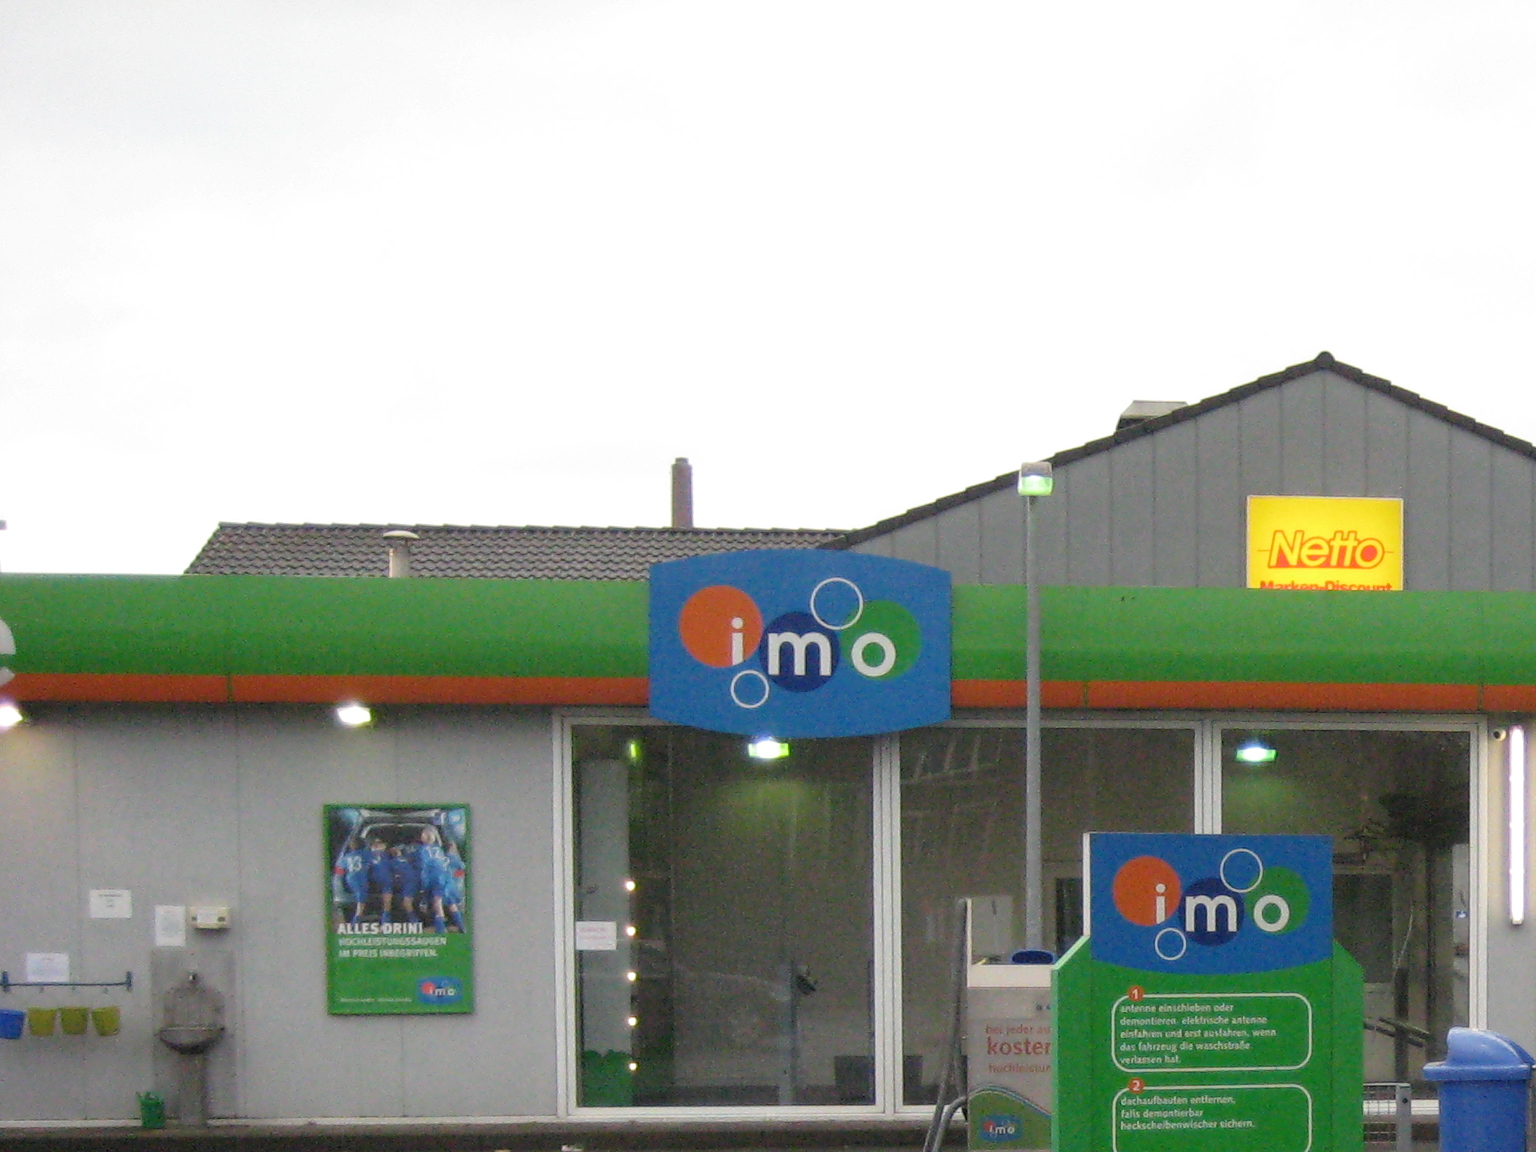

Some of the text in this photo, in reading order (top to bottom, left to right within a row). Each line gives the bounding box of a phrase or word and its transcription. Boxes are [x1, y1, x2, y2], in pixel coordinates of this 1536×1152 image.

[1268, 530, 1385, 569] Netto
[731, 617, 891, 677] imo
[1155, 882, 1290, 932] imo
[337, 922, 379, 934] ALLES
[1121, 1003, 1234, 1013] antenne einschieben oder
[1231, 1016, 1267, 1024] antenne
[1006, 1024, 1034, 1035] jeder
[1165, 1029, 1183, 1038] und
[1120, 1043, 1136, 1051] das
[1138, 1042, 1177, 1052] fahrzeug
[1179, 1041, 1193, 1050] die
[1120, 1096, 1188, 1106] dachaufbauten
[1120, 1108, 1204, 1119] falls demontierbar
[989, 1125, 1016, 1135] imo
[1120, 1120, 1218, 1130] heckscheibenwischer
